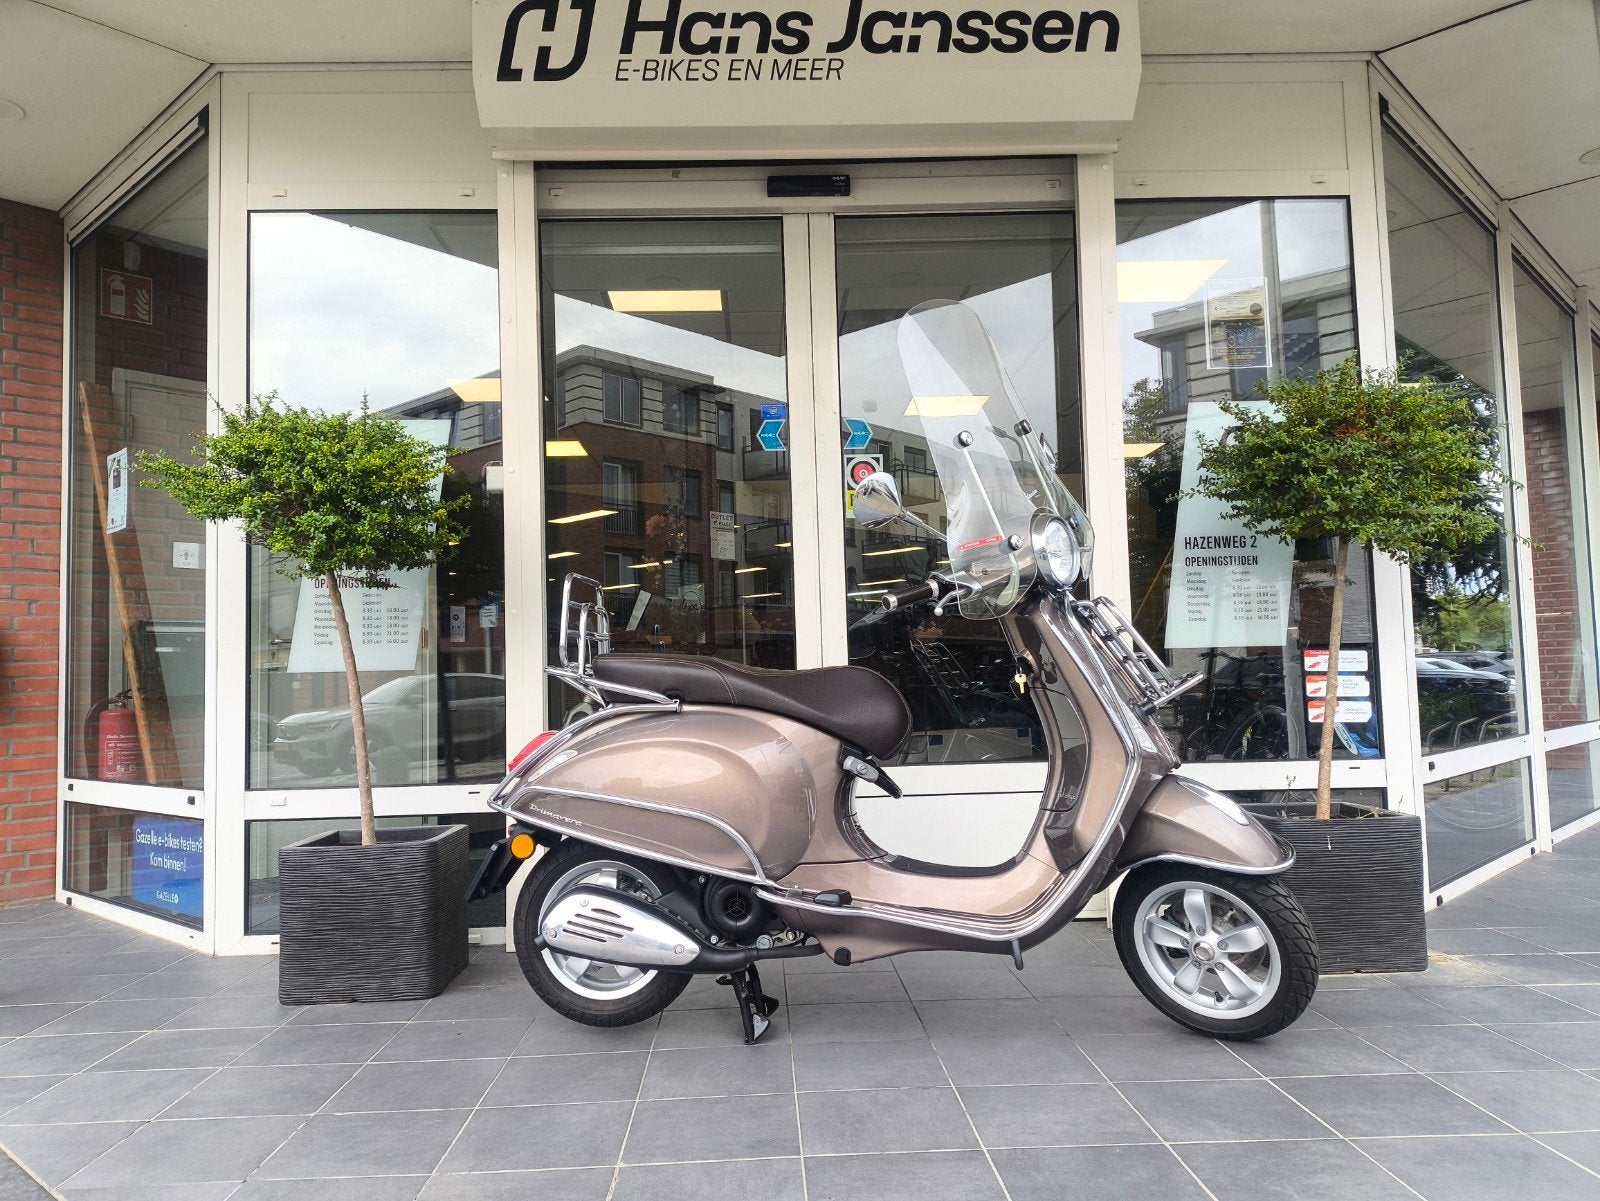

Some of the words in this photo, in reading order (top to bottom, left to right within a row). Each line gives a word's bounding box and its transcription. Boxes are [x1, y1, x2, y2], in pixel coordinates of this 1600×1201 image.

[619, 0, 814, 55] Hans
[826, 0, 1120, 54] Janssen
[614, 58, 720, 82] E-BIKES
[727, 58, 764, 81] EN
[770, 58, 845, 81] MEER
[1184, 535, 1247, 550] HAZENWEG
[1250, 534, 1258, 548] 2
[1184, 554, 1258, 567] OPENINGSTIJDEN
[136, 828, 157, 845] Gazelle
[158, 832, 180, 849] e-bikes
[180, 836, 203, 853] testen?
[149, 851, 163, 867] Kom
[163, 854, 186, 872] binnen!
[156, 890, 175, 903] GAZELLE
